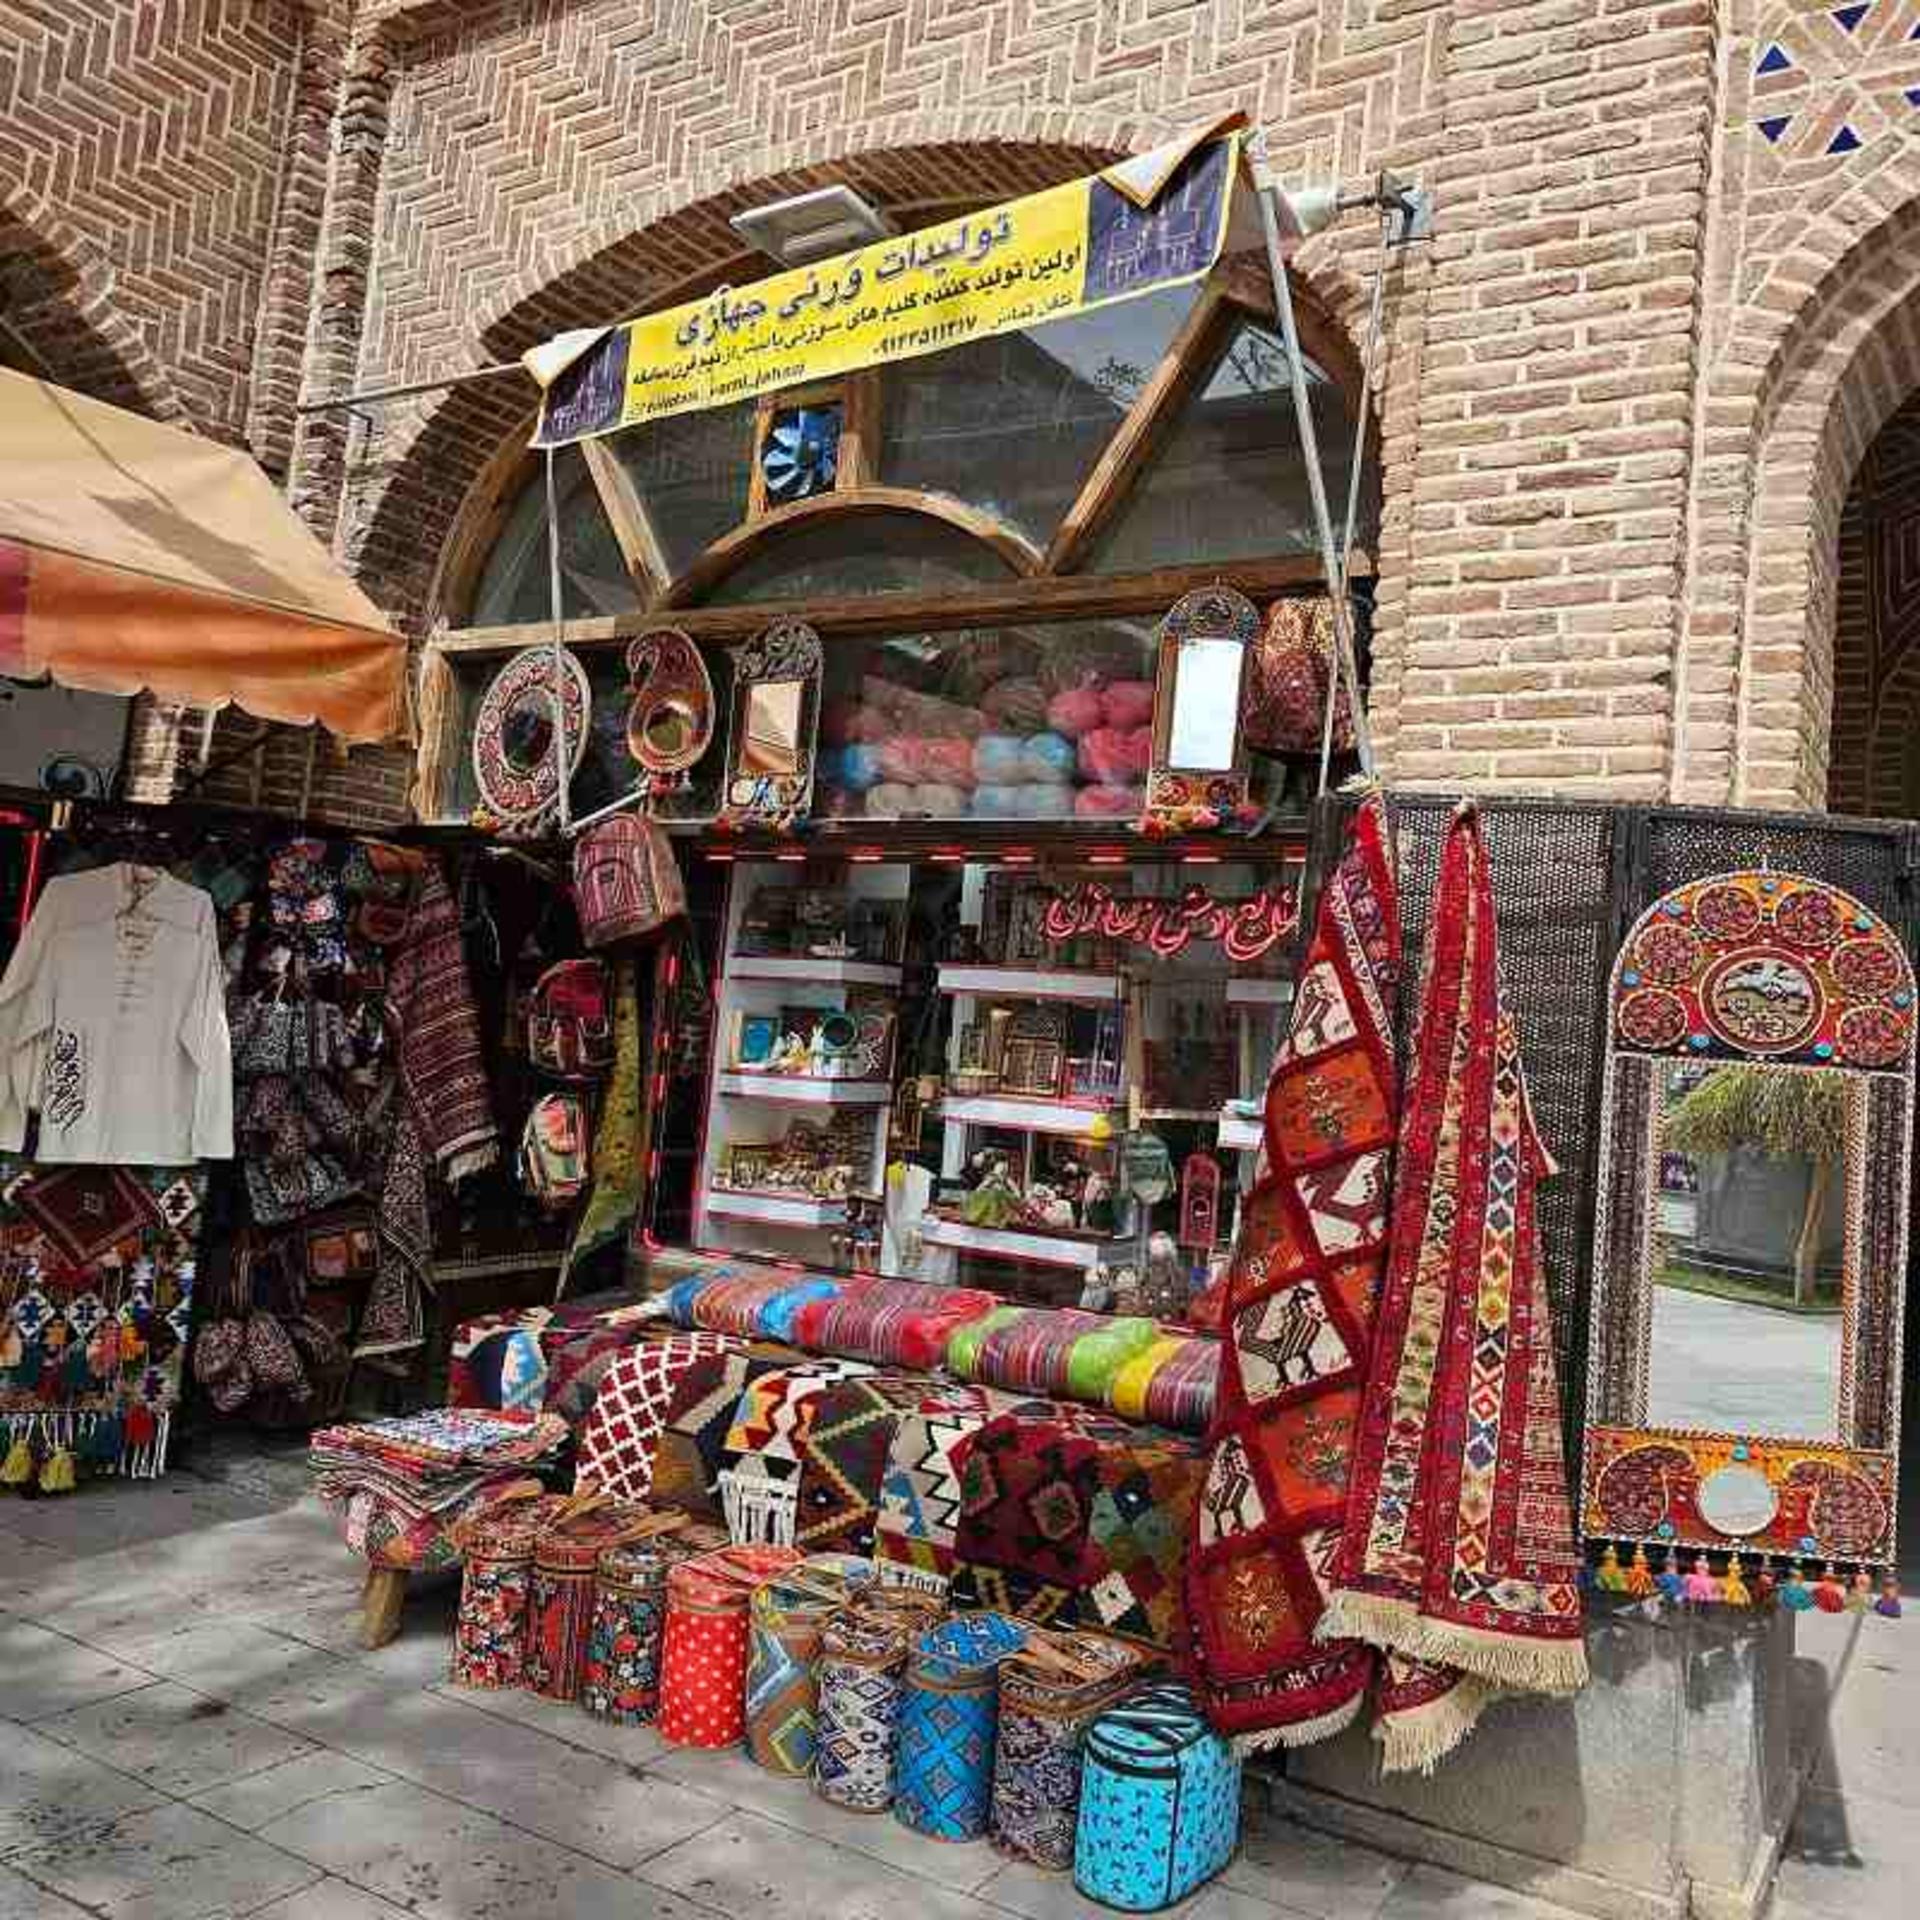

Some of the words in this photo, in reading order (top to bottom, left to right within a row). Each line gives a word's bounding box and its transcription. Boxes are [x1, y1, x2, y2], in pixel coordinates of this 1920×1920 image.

[875, 211, 1011, 282] تولیدات
[1029, 243, 1081, 281] اولین
[974, 260, 1024, 294] تولید
[676, 297, 767, 347] جهازی
